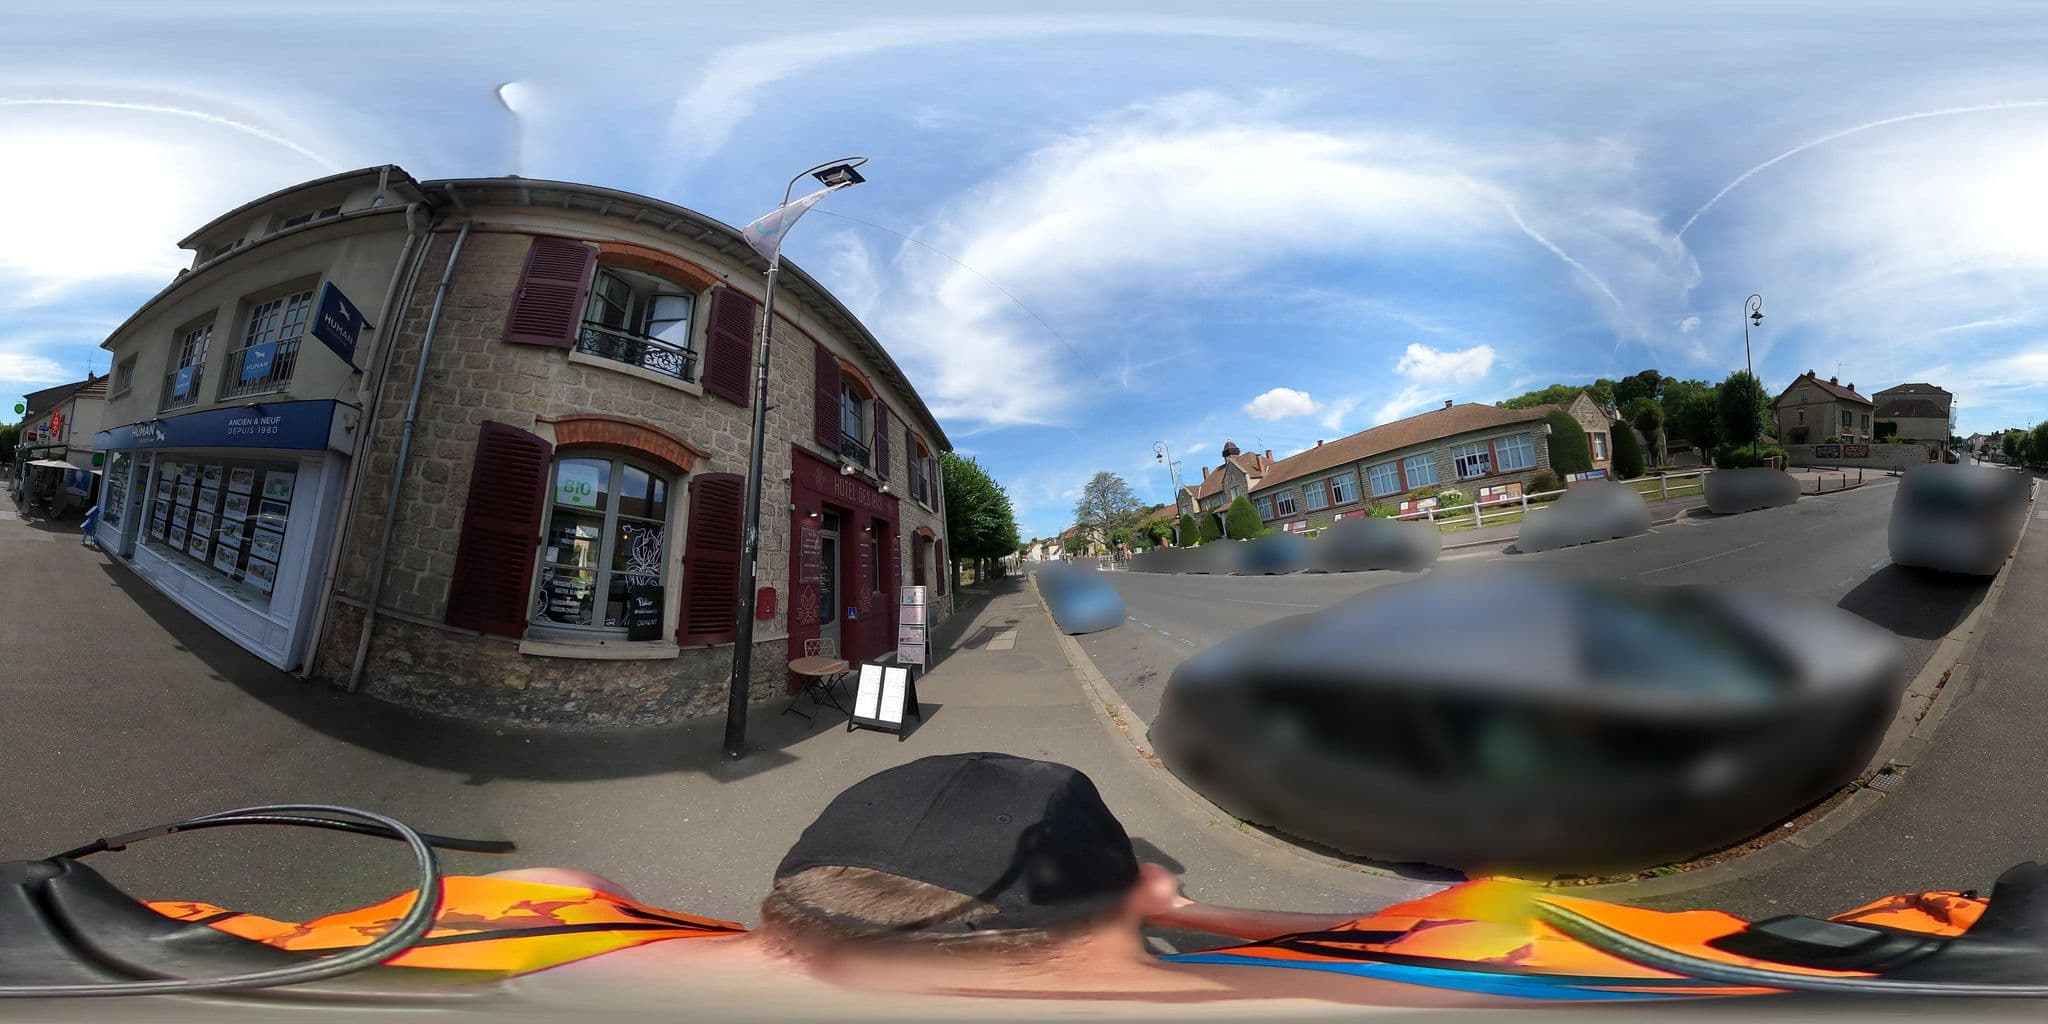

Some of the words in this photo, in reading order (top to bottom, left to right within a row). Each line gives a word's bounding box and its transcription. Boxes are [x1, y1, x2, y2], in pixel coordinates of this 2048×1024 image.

[325, 313, 353, 344] HUMAN
[228, 418, 251, 426] ANCIEN
[260, 416, 281, 425] NEUF
[227, 426, 255, 435] DEPUIS
[257, 426, 278, 434] 1980
